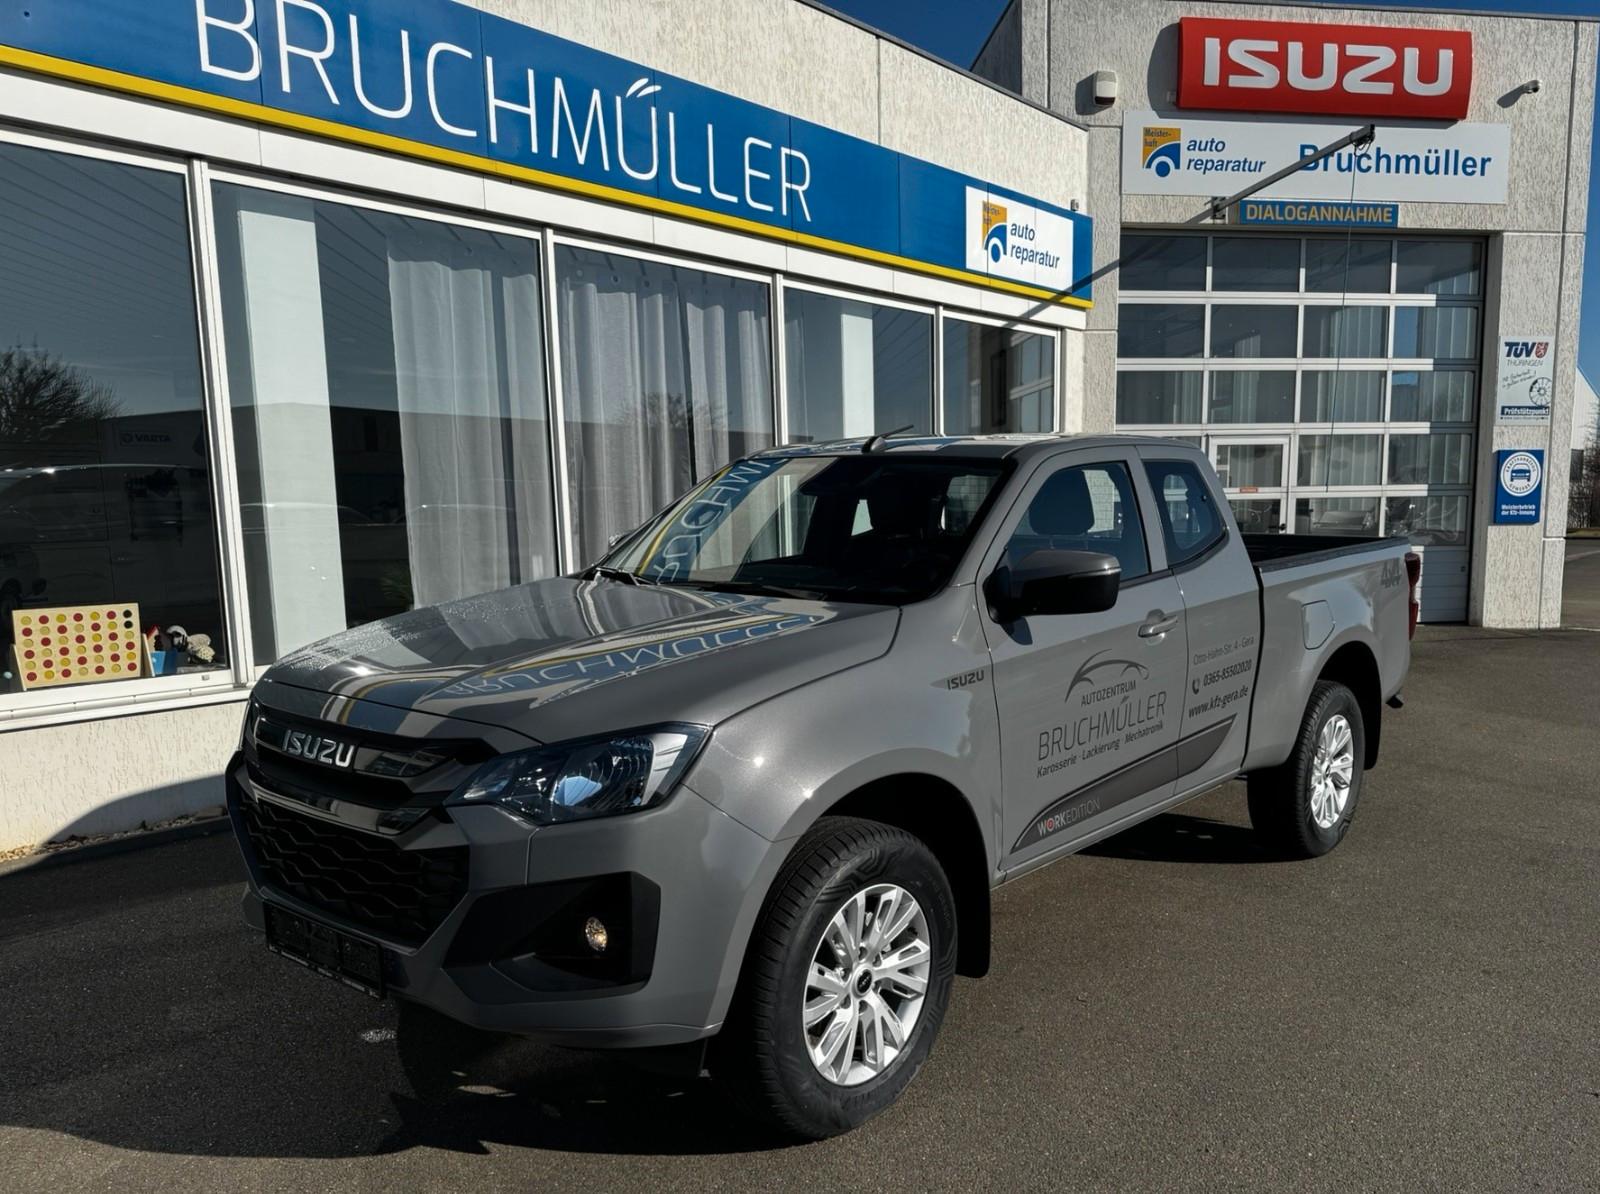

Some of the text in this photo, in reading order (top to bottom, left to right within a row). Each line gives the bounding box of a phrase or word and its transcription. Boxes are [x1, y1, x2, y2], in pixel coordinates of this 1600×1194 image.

[1203, 37, 1454, 96] ISUZU
[195, 0, 812, 222] BRUCHMÜLLER
[1186, 138, 1226, 153] auto
[1299, 144, 1492, 177] Bruchmüller
[1186, 157, 1267, 175] reparatur
[1246, 203, 1394, 223] DIALOGANNAHME
[1010, 222, 1036, 242] auto
[1010, 243, 1061, 269] reparatur
[947, 669, 985, 690] ISUZU
[1080, 680, 1137, 707] AUTOZENTRUM
[1188, 684, 1249, 718] www.kfz-gera.de
[1038, 690, 1168, 761] BRUCHMÜLLER
[282, 729, 355, 768] ISUZU
[1036, 720, 1163, 779] Karosserie Lackierung Mechatronik
